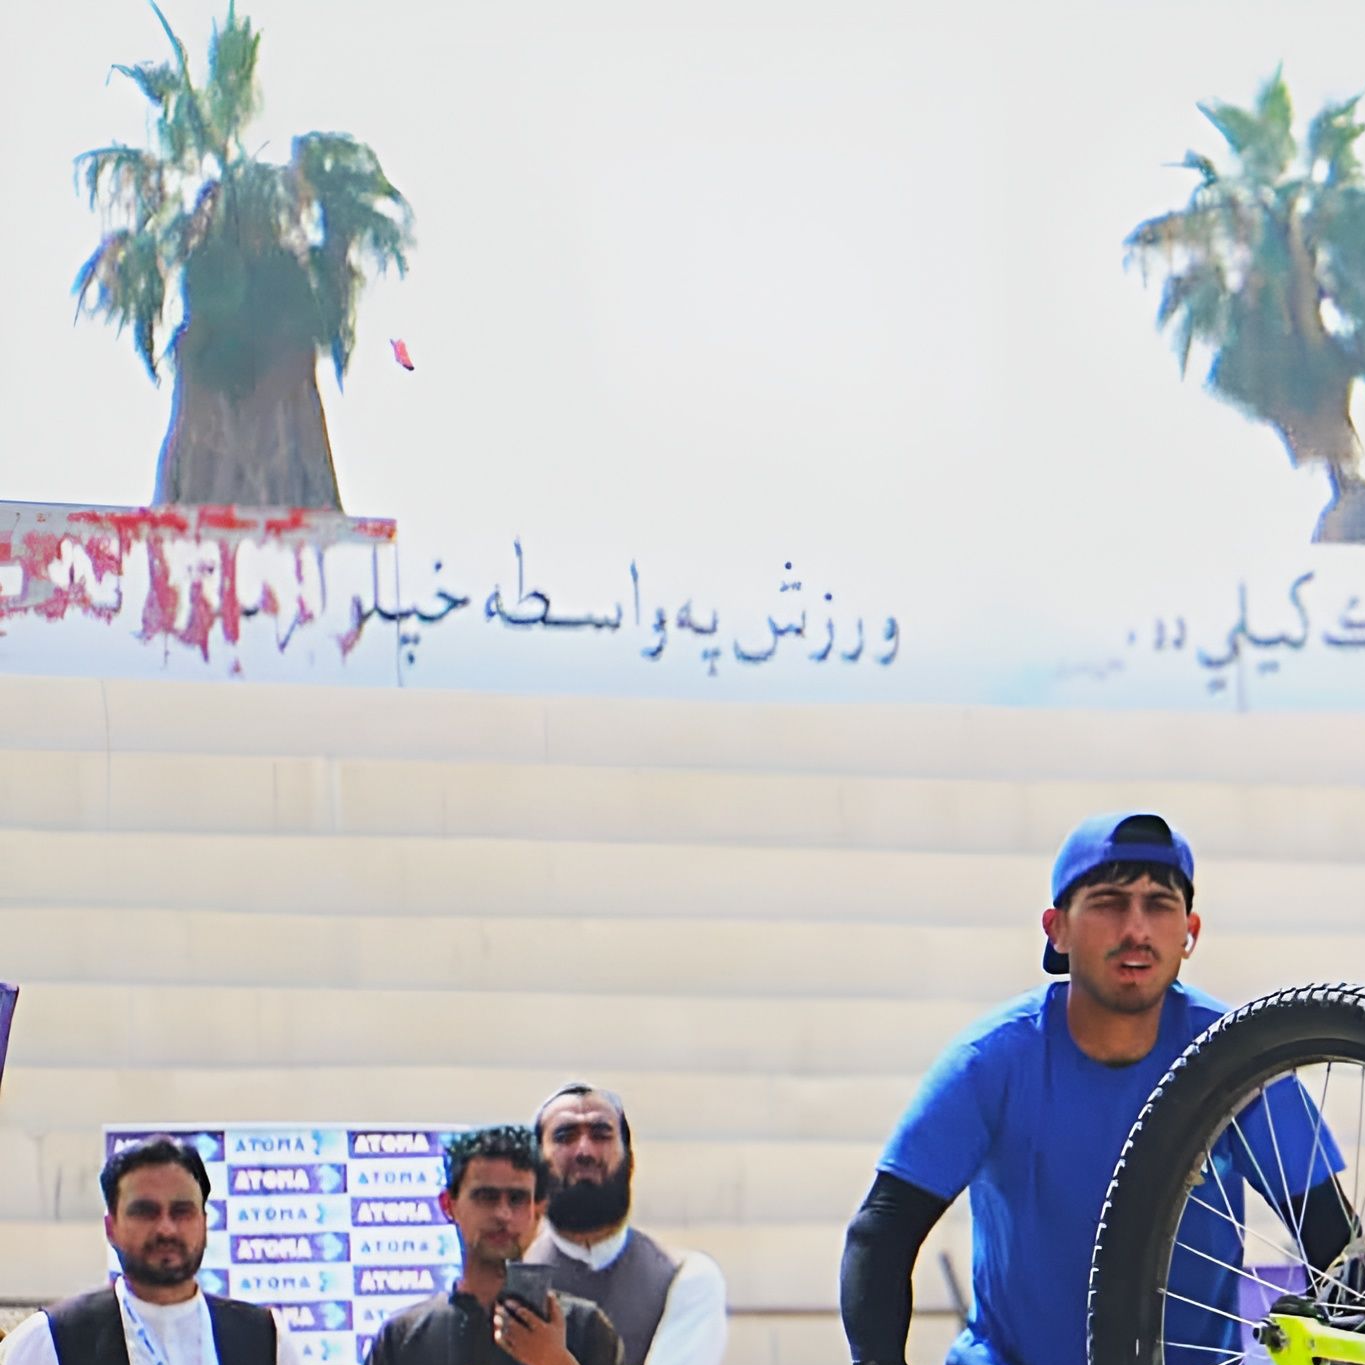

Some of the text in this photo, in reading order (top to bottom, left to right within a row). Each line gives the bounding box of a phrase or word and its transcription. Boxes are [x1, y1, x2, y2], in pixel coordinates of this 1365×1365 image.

[235, 1137, 305, 1152] ATOMA
[354, 1133, 430, 1153] ATOMA
[234, 1169, 311, 1191] ATOMA
[357, 1172, 427, 1185] ATOMA
[237, 1207, 308, 1222] ATOMA
[357, 1202, 433, 1223] ATOMA
[236, 1238, 313, 1260] ATOMA
[359, 1270, 435, 1292] ATOMA
